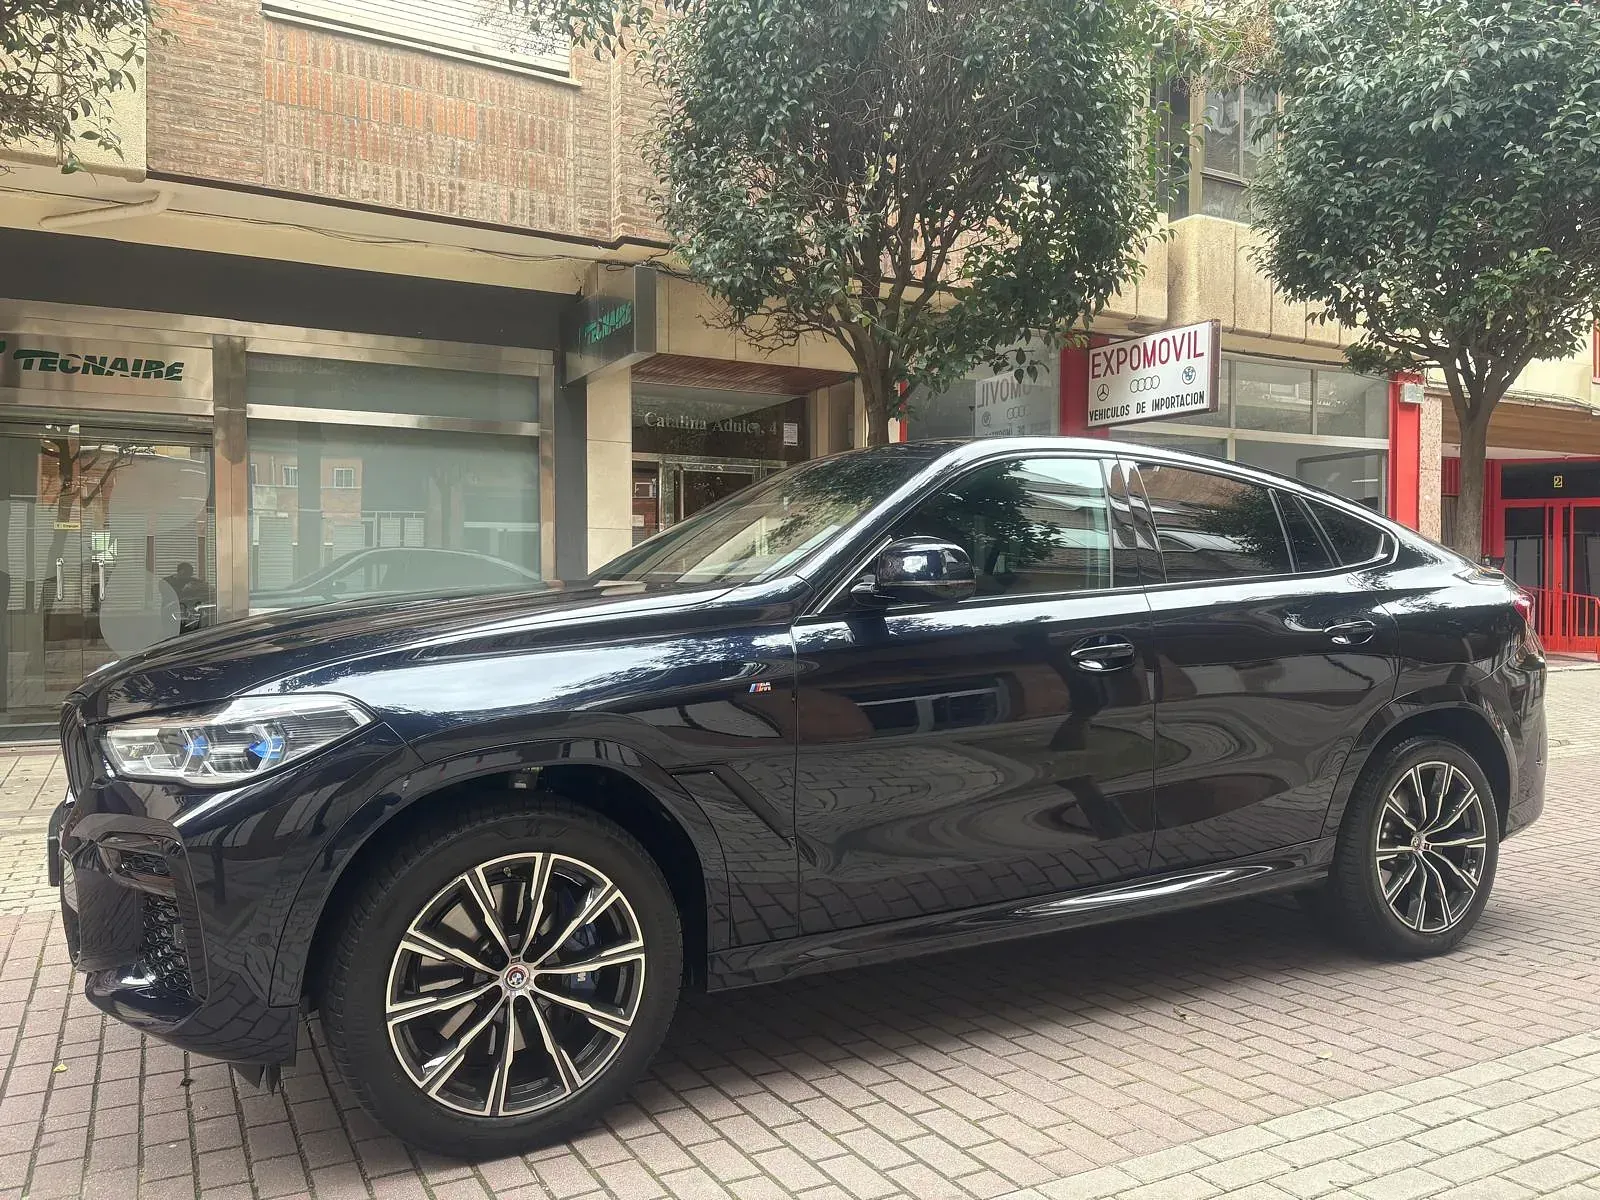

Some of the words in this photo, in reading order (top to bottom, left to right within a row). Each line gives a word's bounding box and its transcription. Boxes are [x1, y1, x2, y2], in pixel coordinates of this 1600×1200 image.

[584, 302, 631, 344] TECNAIRE
[13, 349, 184, 381] TECNAIRE
[1091, 330, 1204, 379] EXPOMOVIL
[1089, 404, 1130, 421] VEHICULOS
[1136, 401, 1146, 414] DE
[1151, 390, 1205, 412] IMPORTACION
[1554, 476, 1562, 487] 2
